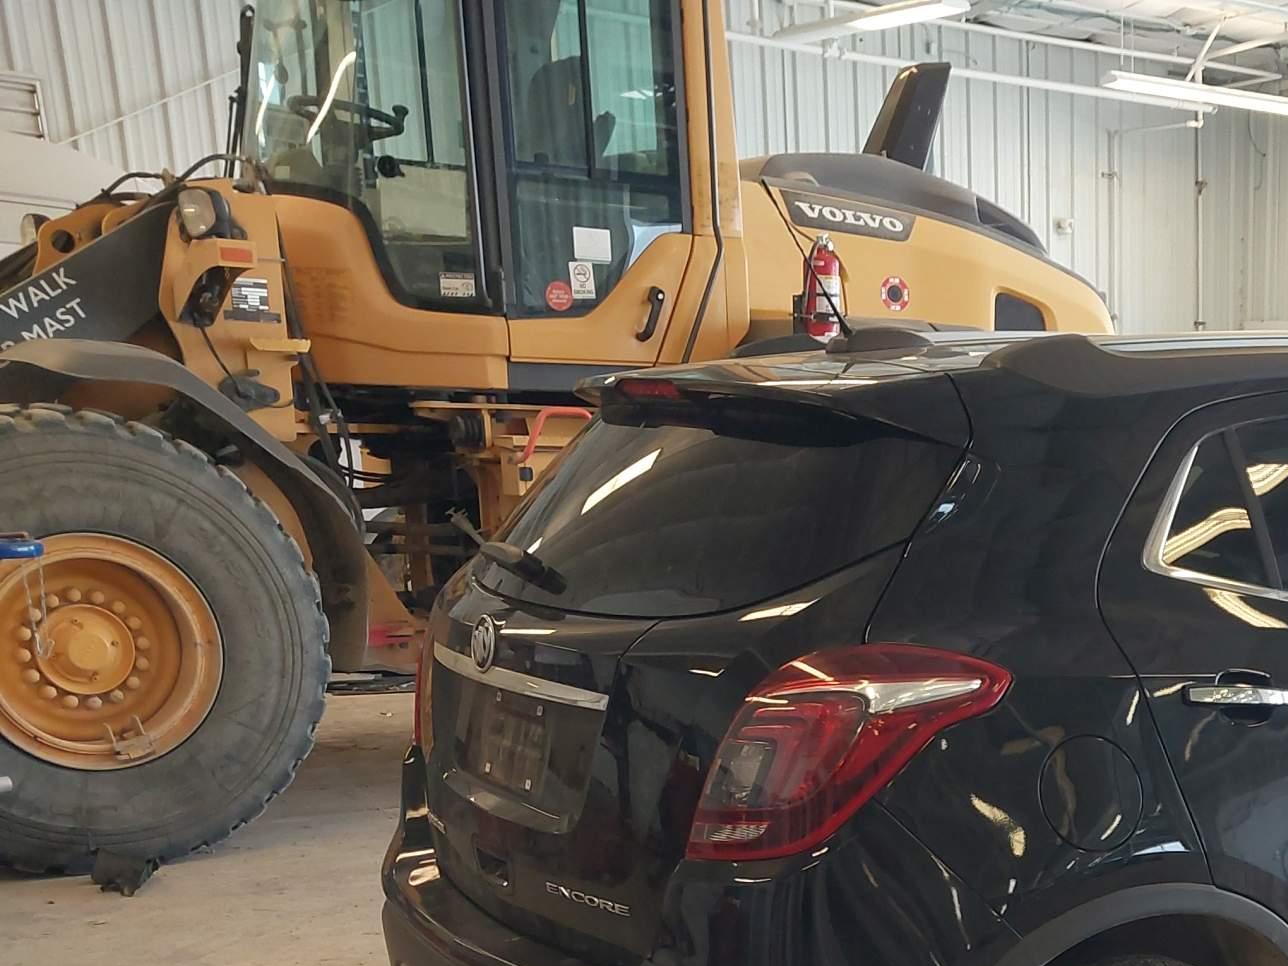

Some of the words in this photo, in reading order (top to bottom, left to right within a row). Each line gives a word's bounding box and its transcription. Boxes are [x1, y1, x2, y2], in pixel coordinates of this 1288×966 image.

[795, 201, 904, 232] VOLVO
[0, 267, 77, 319] WALK
[21, 298, 86, 340] MAST
[545, 881, 631, 917] ENCORE
